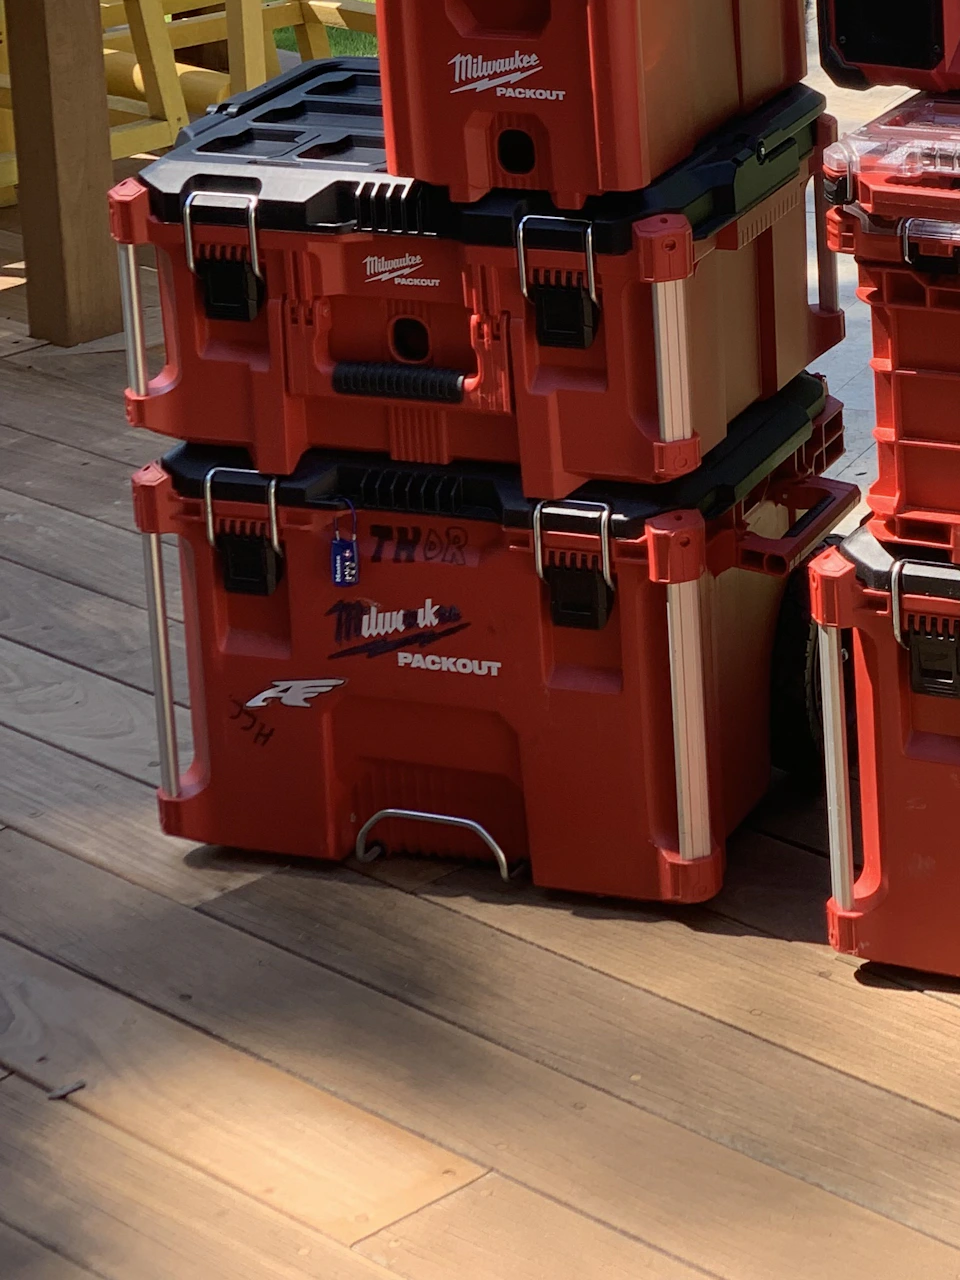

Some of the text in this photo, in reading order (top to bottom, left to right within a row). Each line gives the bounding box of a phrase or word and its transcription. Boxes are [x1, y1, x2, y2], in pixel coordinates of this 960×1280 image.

[447, 50, 540, 83] Milwaukee
[496, 86, 566, 100] PACKOUT
[362, 252, 422, 276] Milwaukee
[394, 277, 440, 287] PACKOUT
[397, 652, 501, 676] PACKOUT
